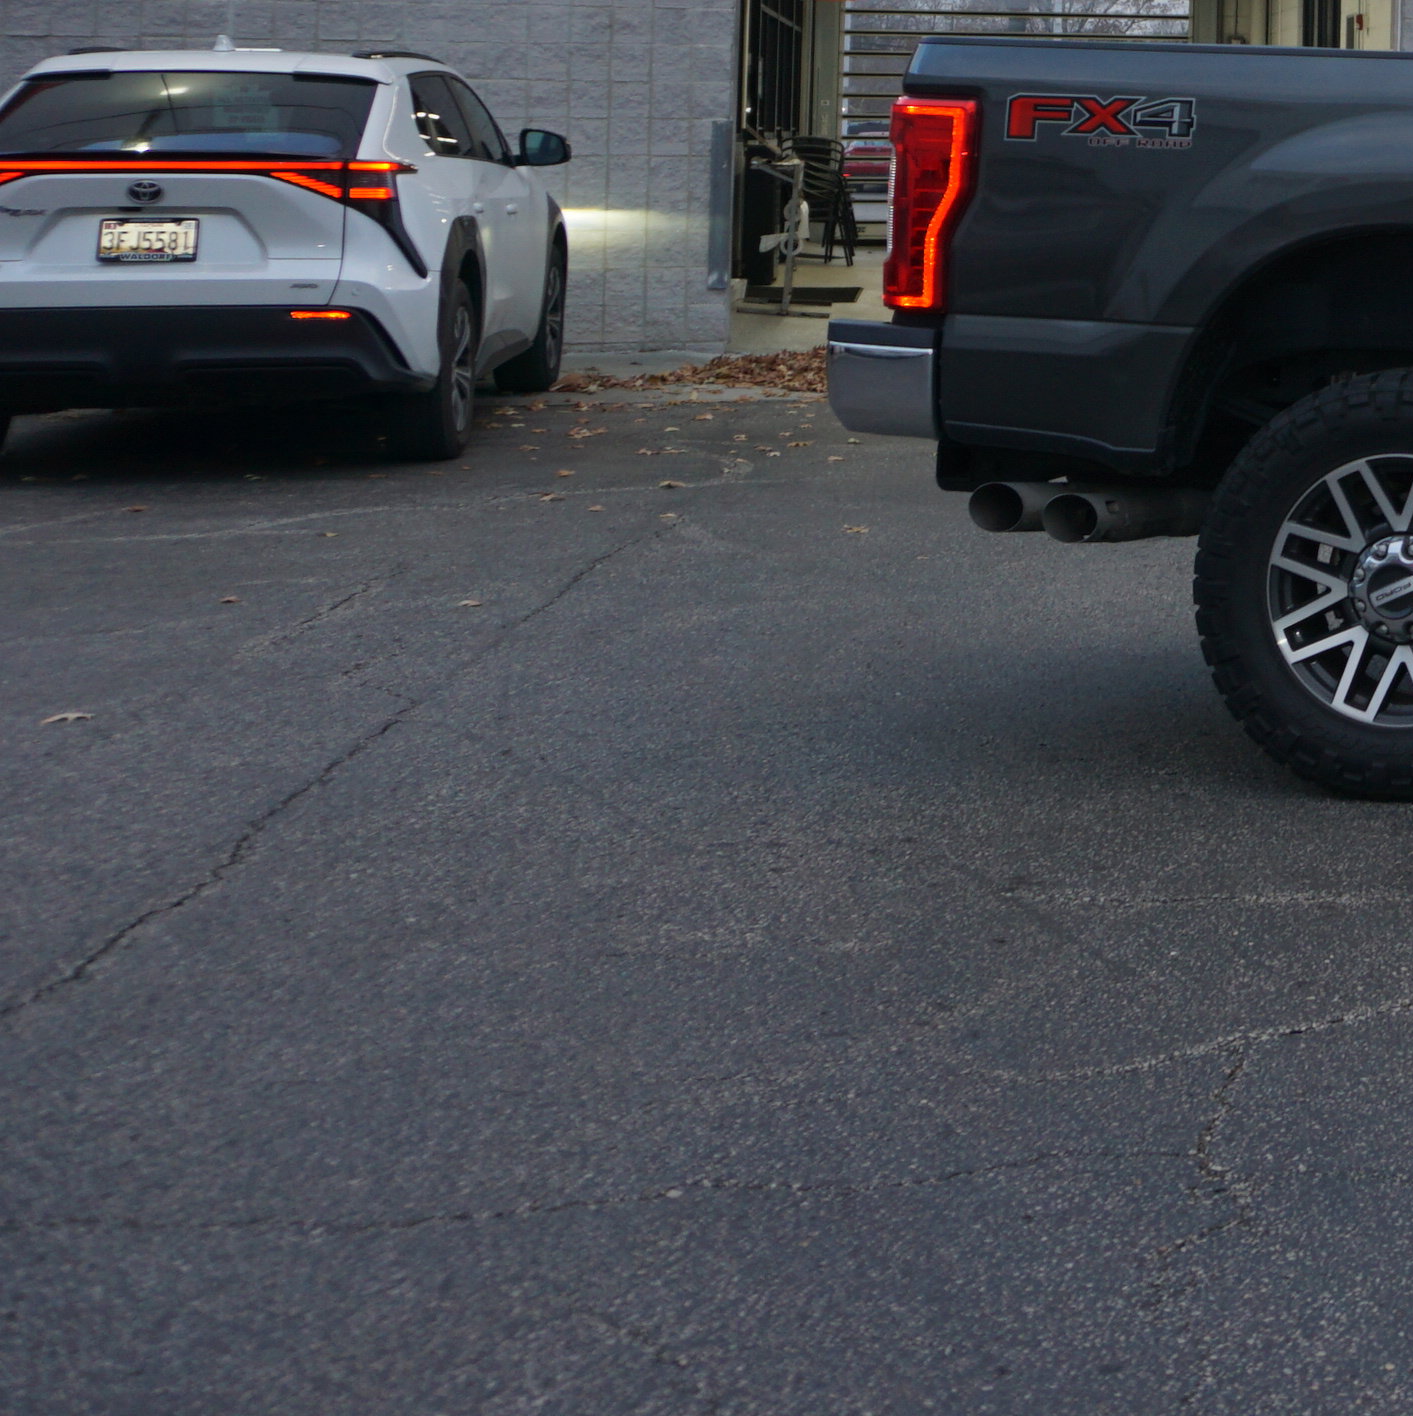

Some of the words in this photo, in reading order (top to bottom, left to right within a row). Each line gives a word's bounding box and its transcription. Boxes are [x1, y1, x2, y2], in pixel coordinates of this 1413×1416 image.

[1004, 93, 1197, 141] FX4
[1088, 136, 1130, 147] OFF
[1136, 137, 1192, 149] ROAD
[102, 230, 192, 251] 3FJ5581
[120, 252, 173, 261] WALDORF
